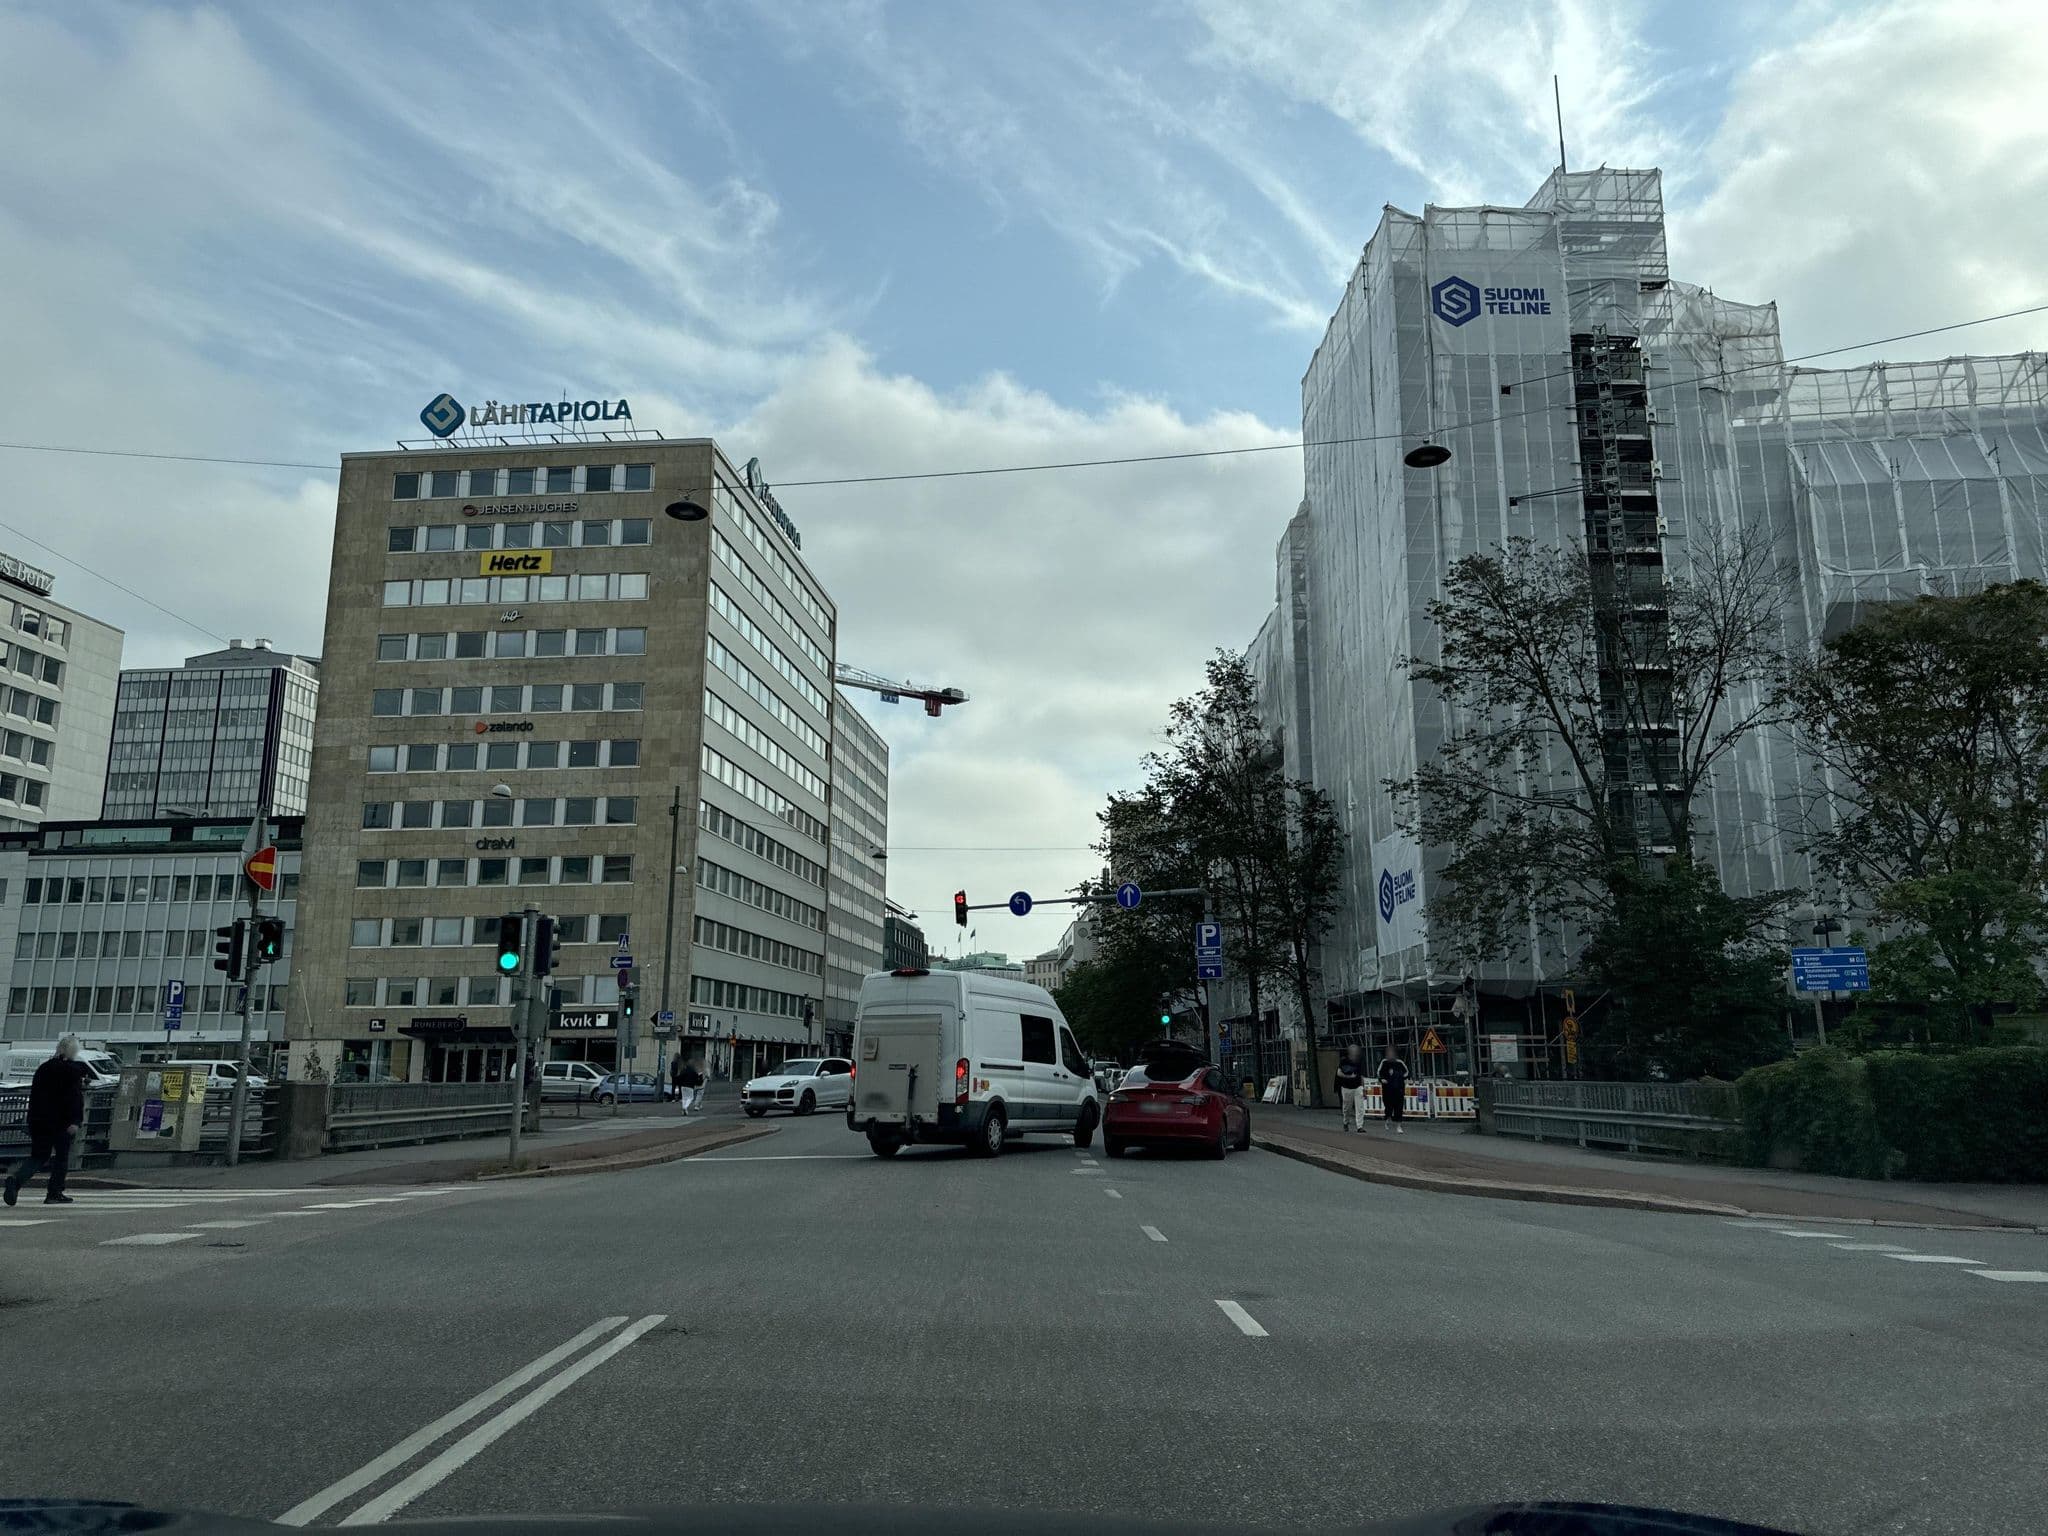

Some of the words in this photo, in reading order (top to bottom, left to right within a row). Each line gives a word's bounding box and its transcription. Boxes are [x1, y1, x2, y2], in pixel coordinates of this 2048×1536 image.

[1484, 288, 1545, 301] SUOMI
[1485, 302, 1552, 315] TELINE
[469, 399, 632, 426] LÄHITAPIOLA
[478, 502, 524, 516] JENSEN
[529, 501, 578, 513] HUGHES
[488, 552, 542, 571] Hertz
[489, 720, 534, 732] zalando
[1394, 868, 1414, 890] SUOMI
[1395, 882, 1416, 906] TELINE
[1201, 924, 1217, 946] P
[170, 981, 182, 1004] P
[560, 1013, 598, 1027] kvik
